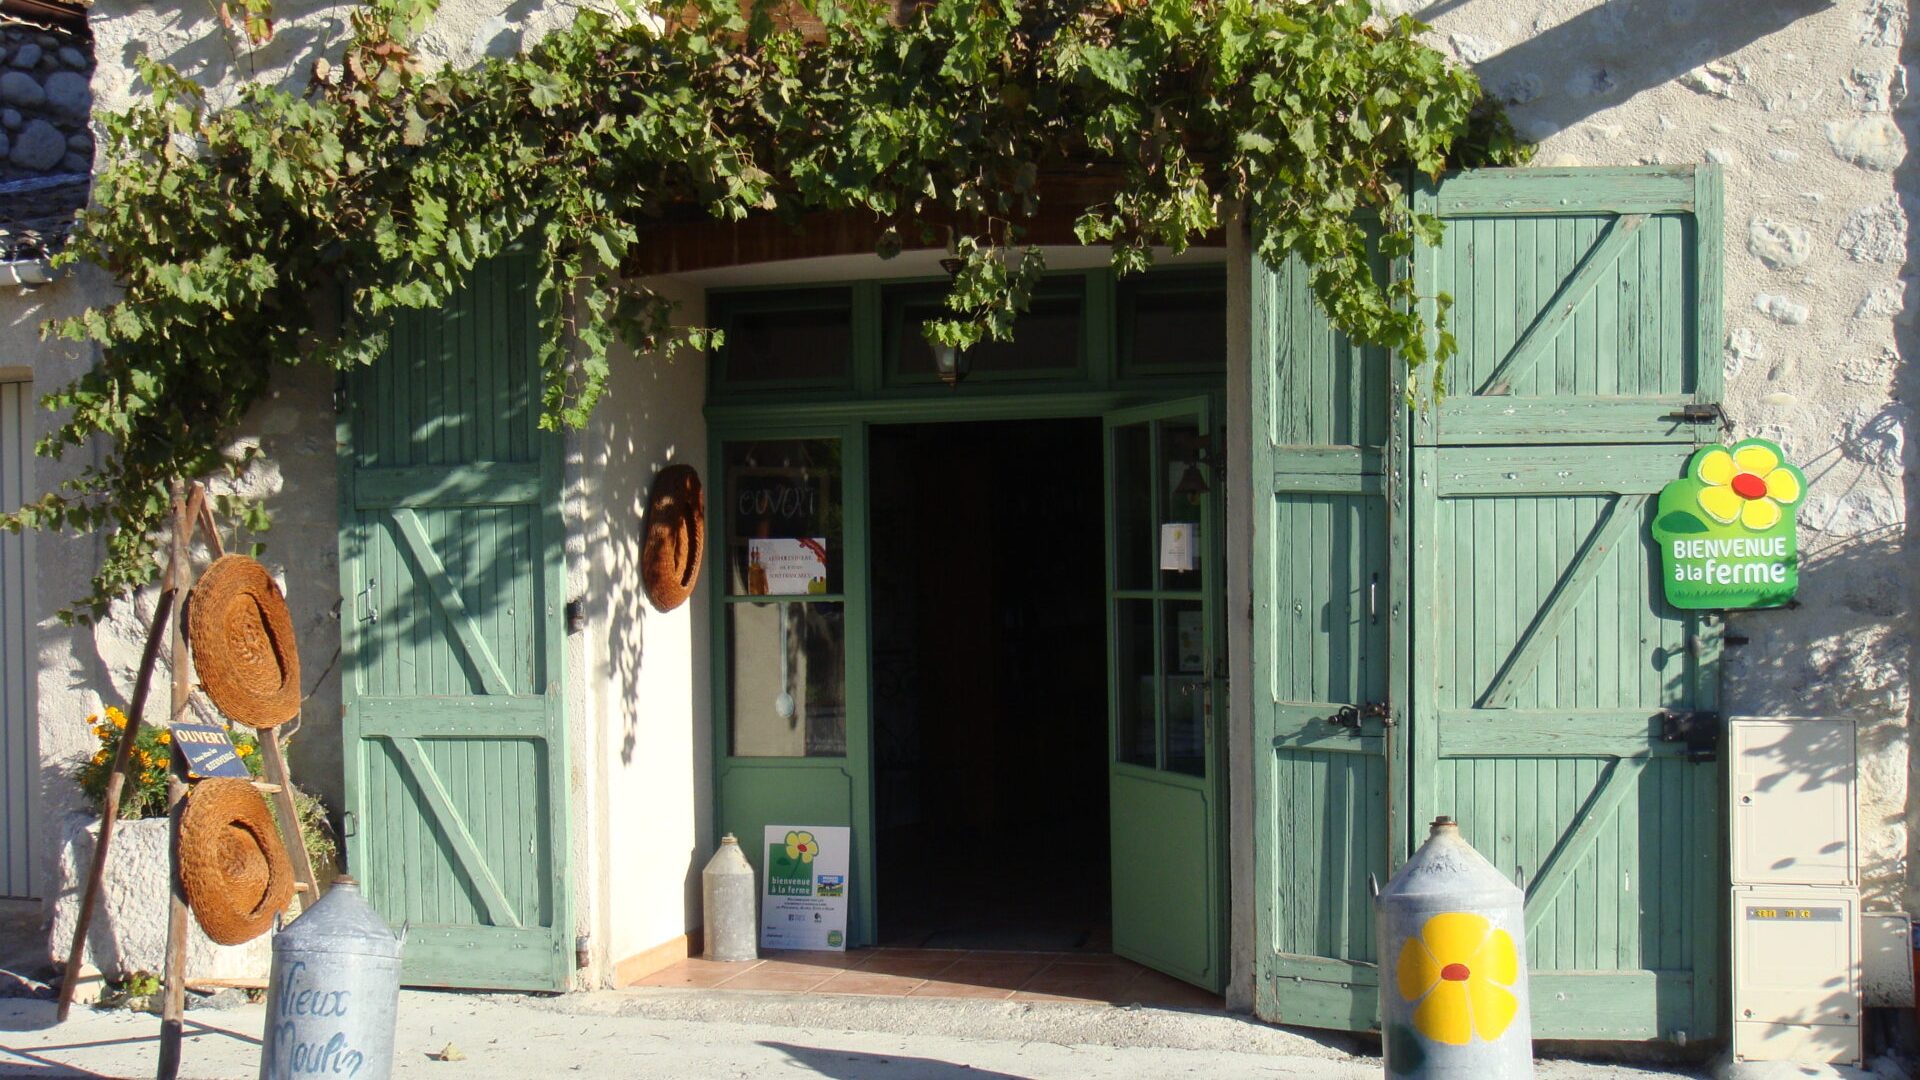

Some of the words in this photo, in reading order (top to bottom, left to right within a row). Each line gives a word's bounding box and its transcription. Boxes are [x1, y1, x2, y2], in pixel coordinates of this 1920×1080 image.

[1673, 537, 1787, 559] BIENVENUE
[1674, 563, 1685, 582] à
[1687, 564, 1703, 581] la
[1705, 559, 1786, 584] ferme
[176, 730, 227, 744] OUVERT
[772, 877, 810, 885] bienvenue
[772, 886, 776, 894] à
[778, 886, 786, 894] la
[787, 886, 811, 895] ferme
[279, 961, 352, 1018] Vieux
[270, 1021, 364, 1080] Moulin
